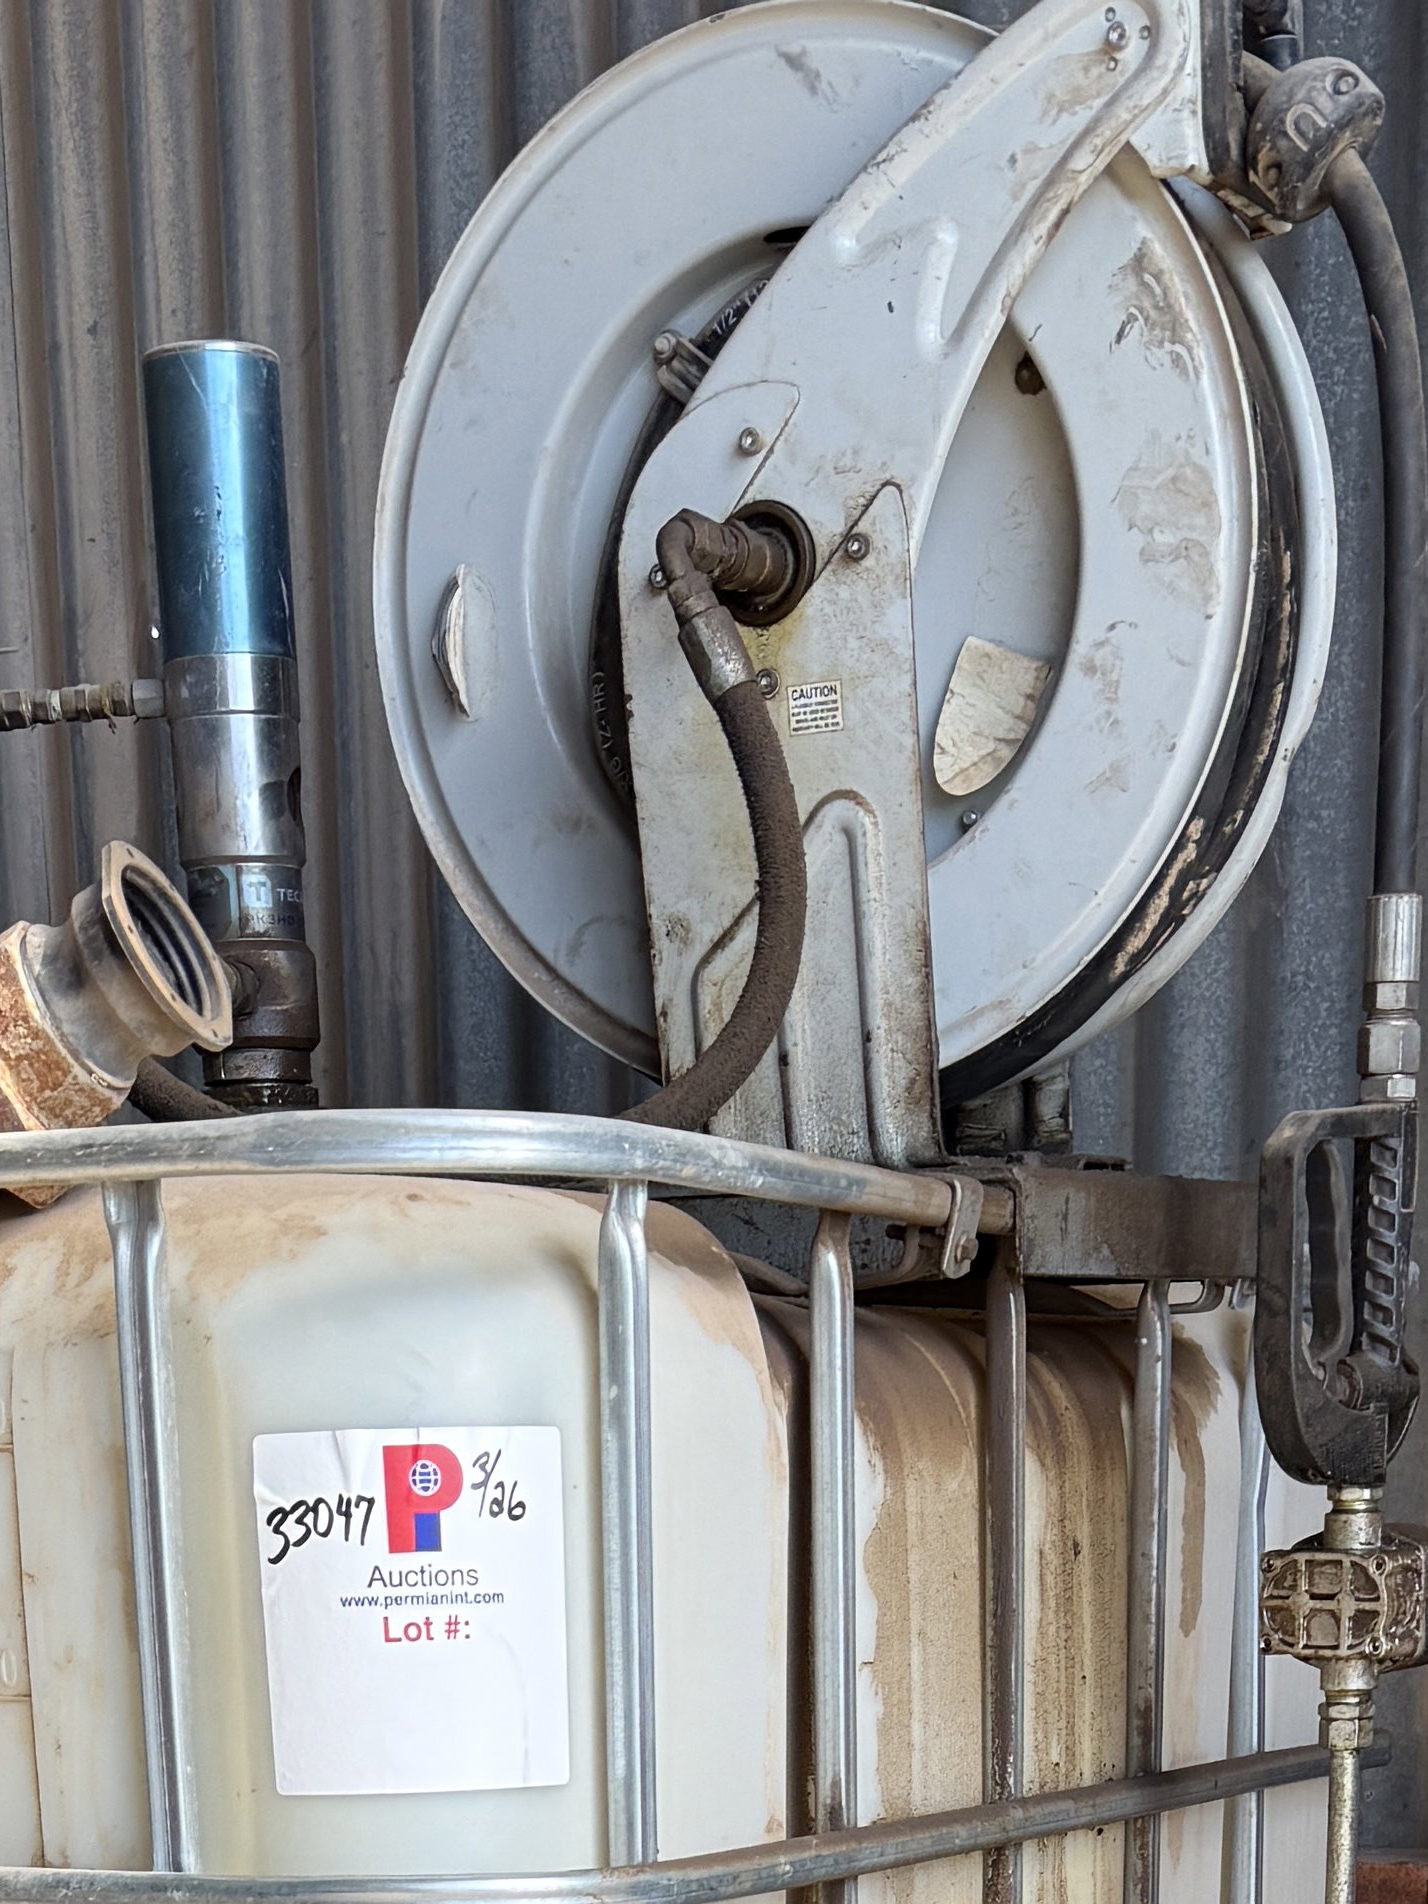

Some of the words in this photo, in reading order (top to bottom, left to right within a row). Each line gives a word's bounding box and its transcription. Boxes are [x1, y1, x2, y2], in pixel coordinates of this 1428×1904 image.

[791, 684, 838, 701] CAUTION
[266, 1493, 376, 1566] 33047
[366, 1564, 479, 1589] Auctions
[339, 1590, 505, 1610] www.permianint.com
[382, 1616, 434, 1643] Lot
[444, 1614, 472, 1641] #:
